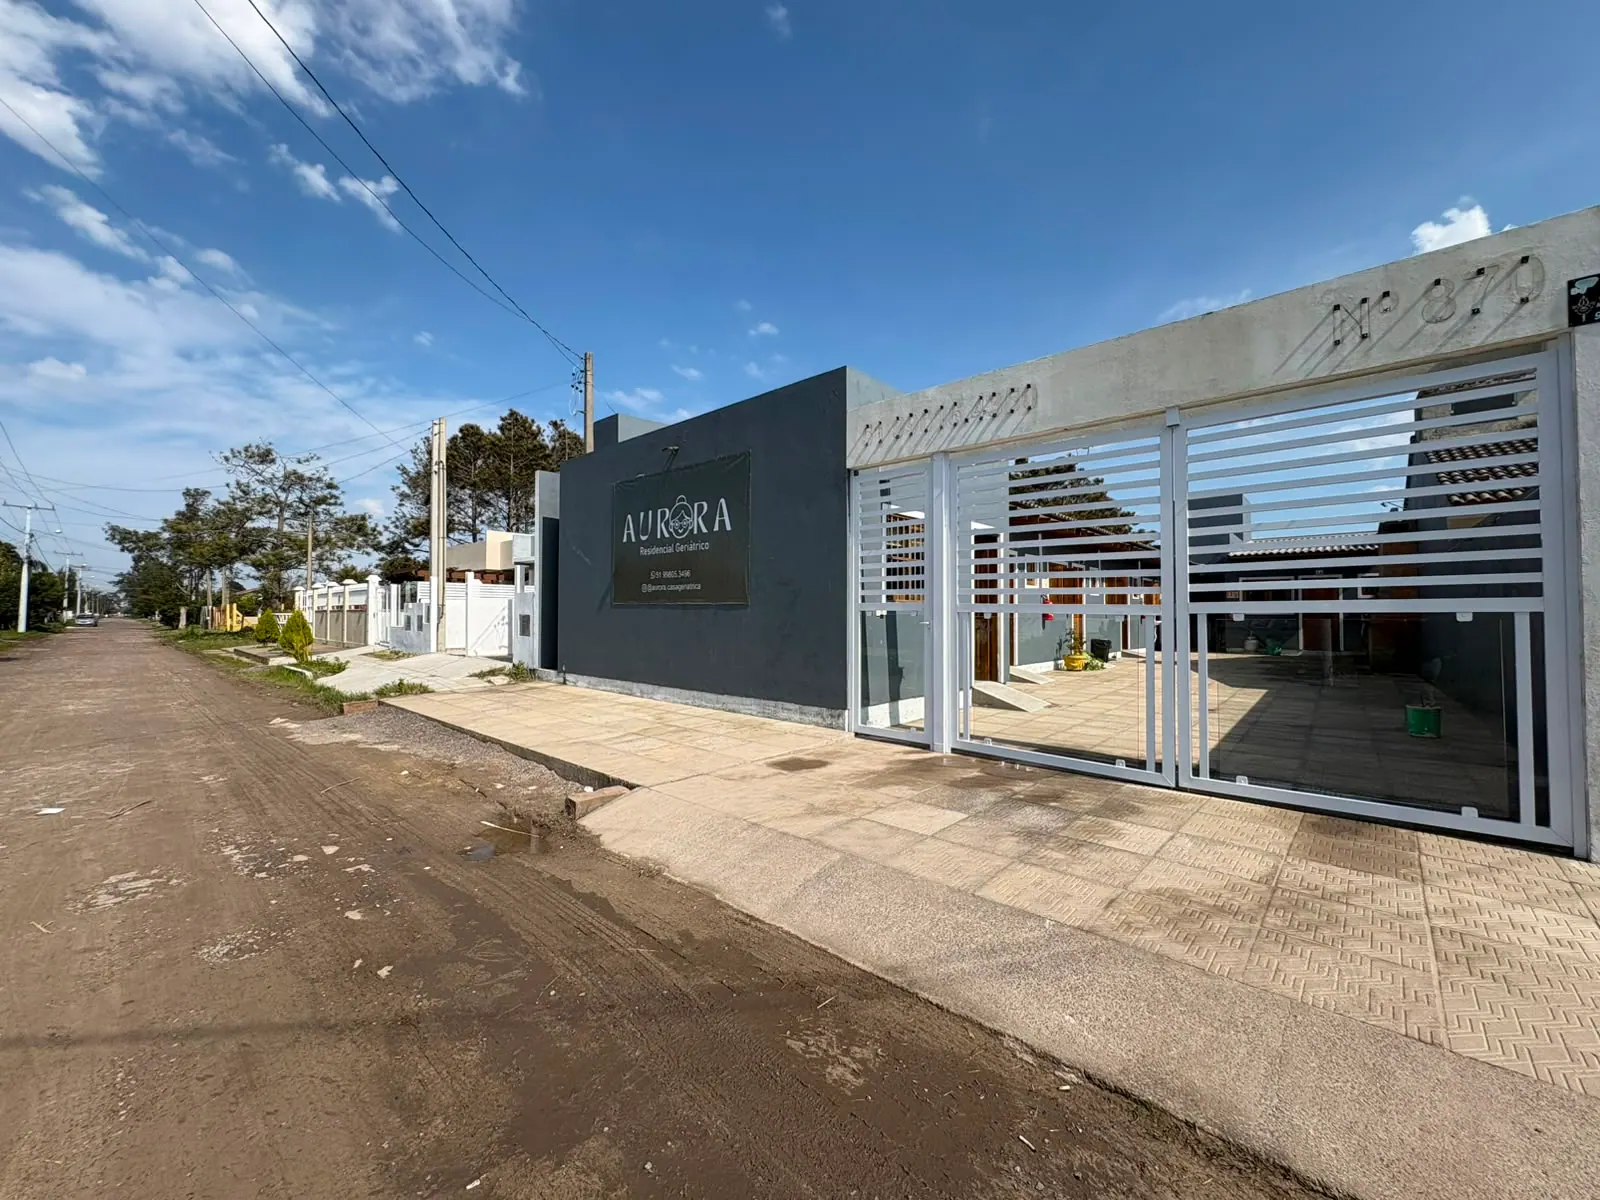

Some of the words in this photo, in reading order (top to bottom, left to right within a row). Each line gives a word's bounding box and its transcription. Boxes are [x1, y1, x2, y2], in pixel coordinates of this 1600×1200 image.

[1421, 254, 1545, 324] 870
[623, 495, 732, 543] AURORA
[640, 543, 674, 556] Residencial
